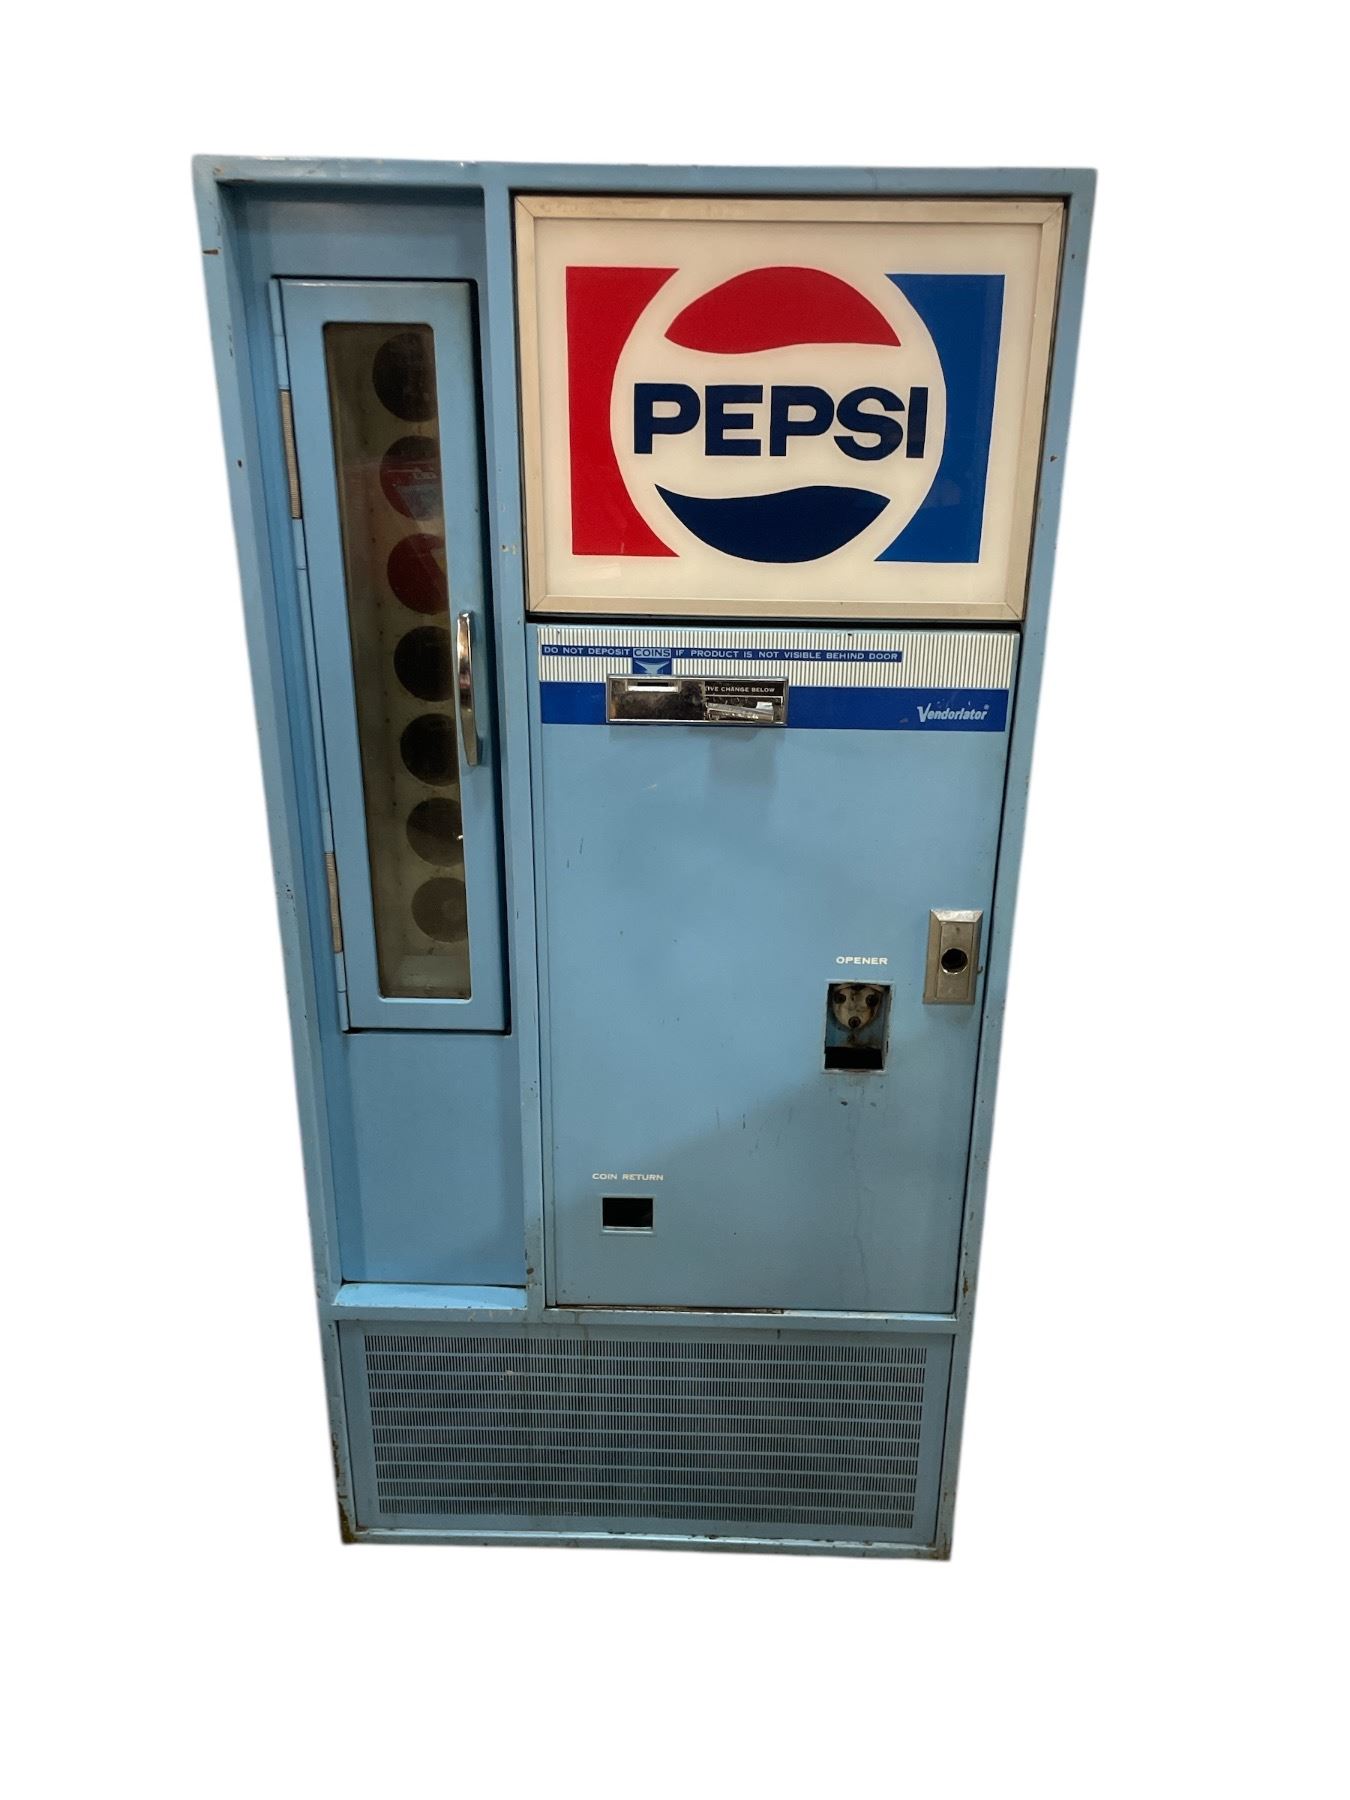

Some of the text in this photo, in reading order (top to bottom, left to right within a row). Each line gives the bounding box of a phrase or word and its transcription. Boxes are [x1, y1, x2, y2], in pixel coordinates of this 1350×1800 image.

[634, 383, 928, 461] PEPSI
[588, 648, 630, 656] DEPOSIT
[634, 649, 671, 657] COINS
[691, 650, 738, 658] PRODUCT
[784, 651, 821, 659] VISIBLE
[826, 652, 864, 660] BEHIND
[917, 703, 987, 722] Vendorlator
[836, 956, 888, 965] OPENER
[623, 1173, 664, 1181] RETURN
